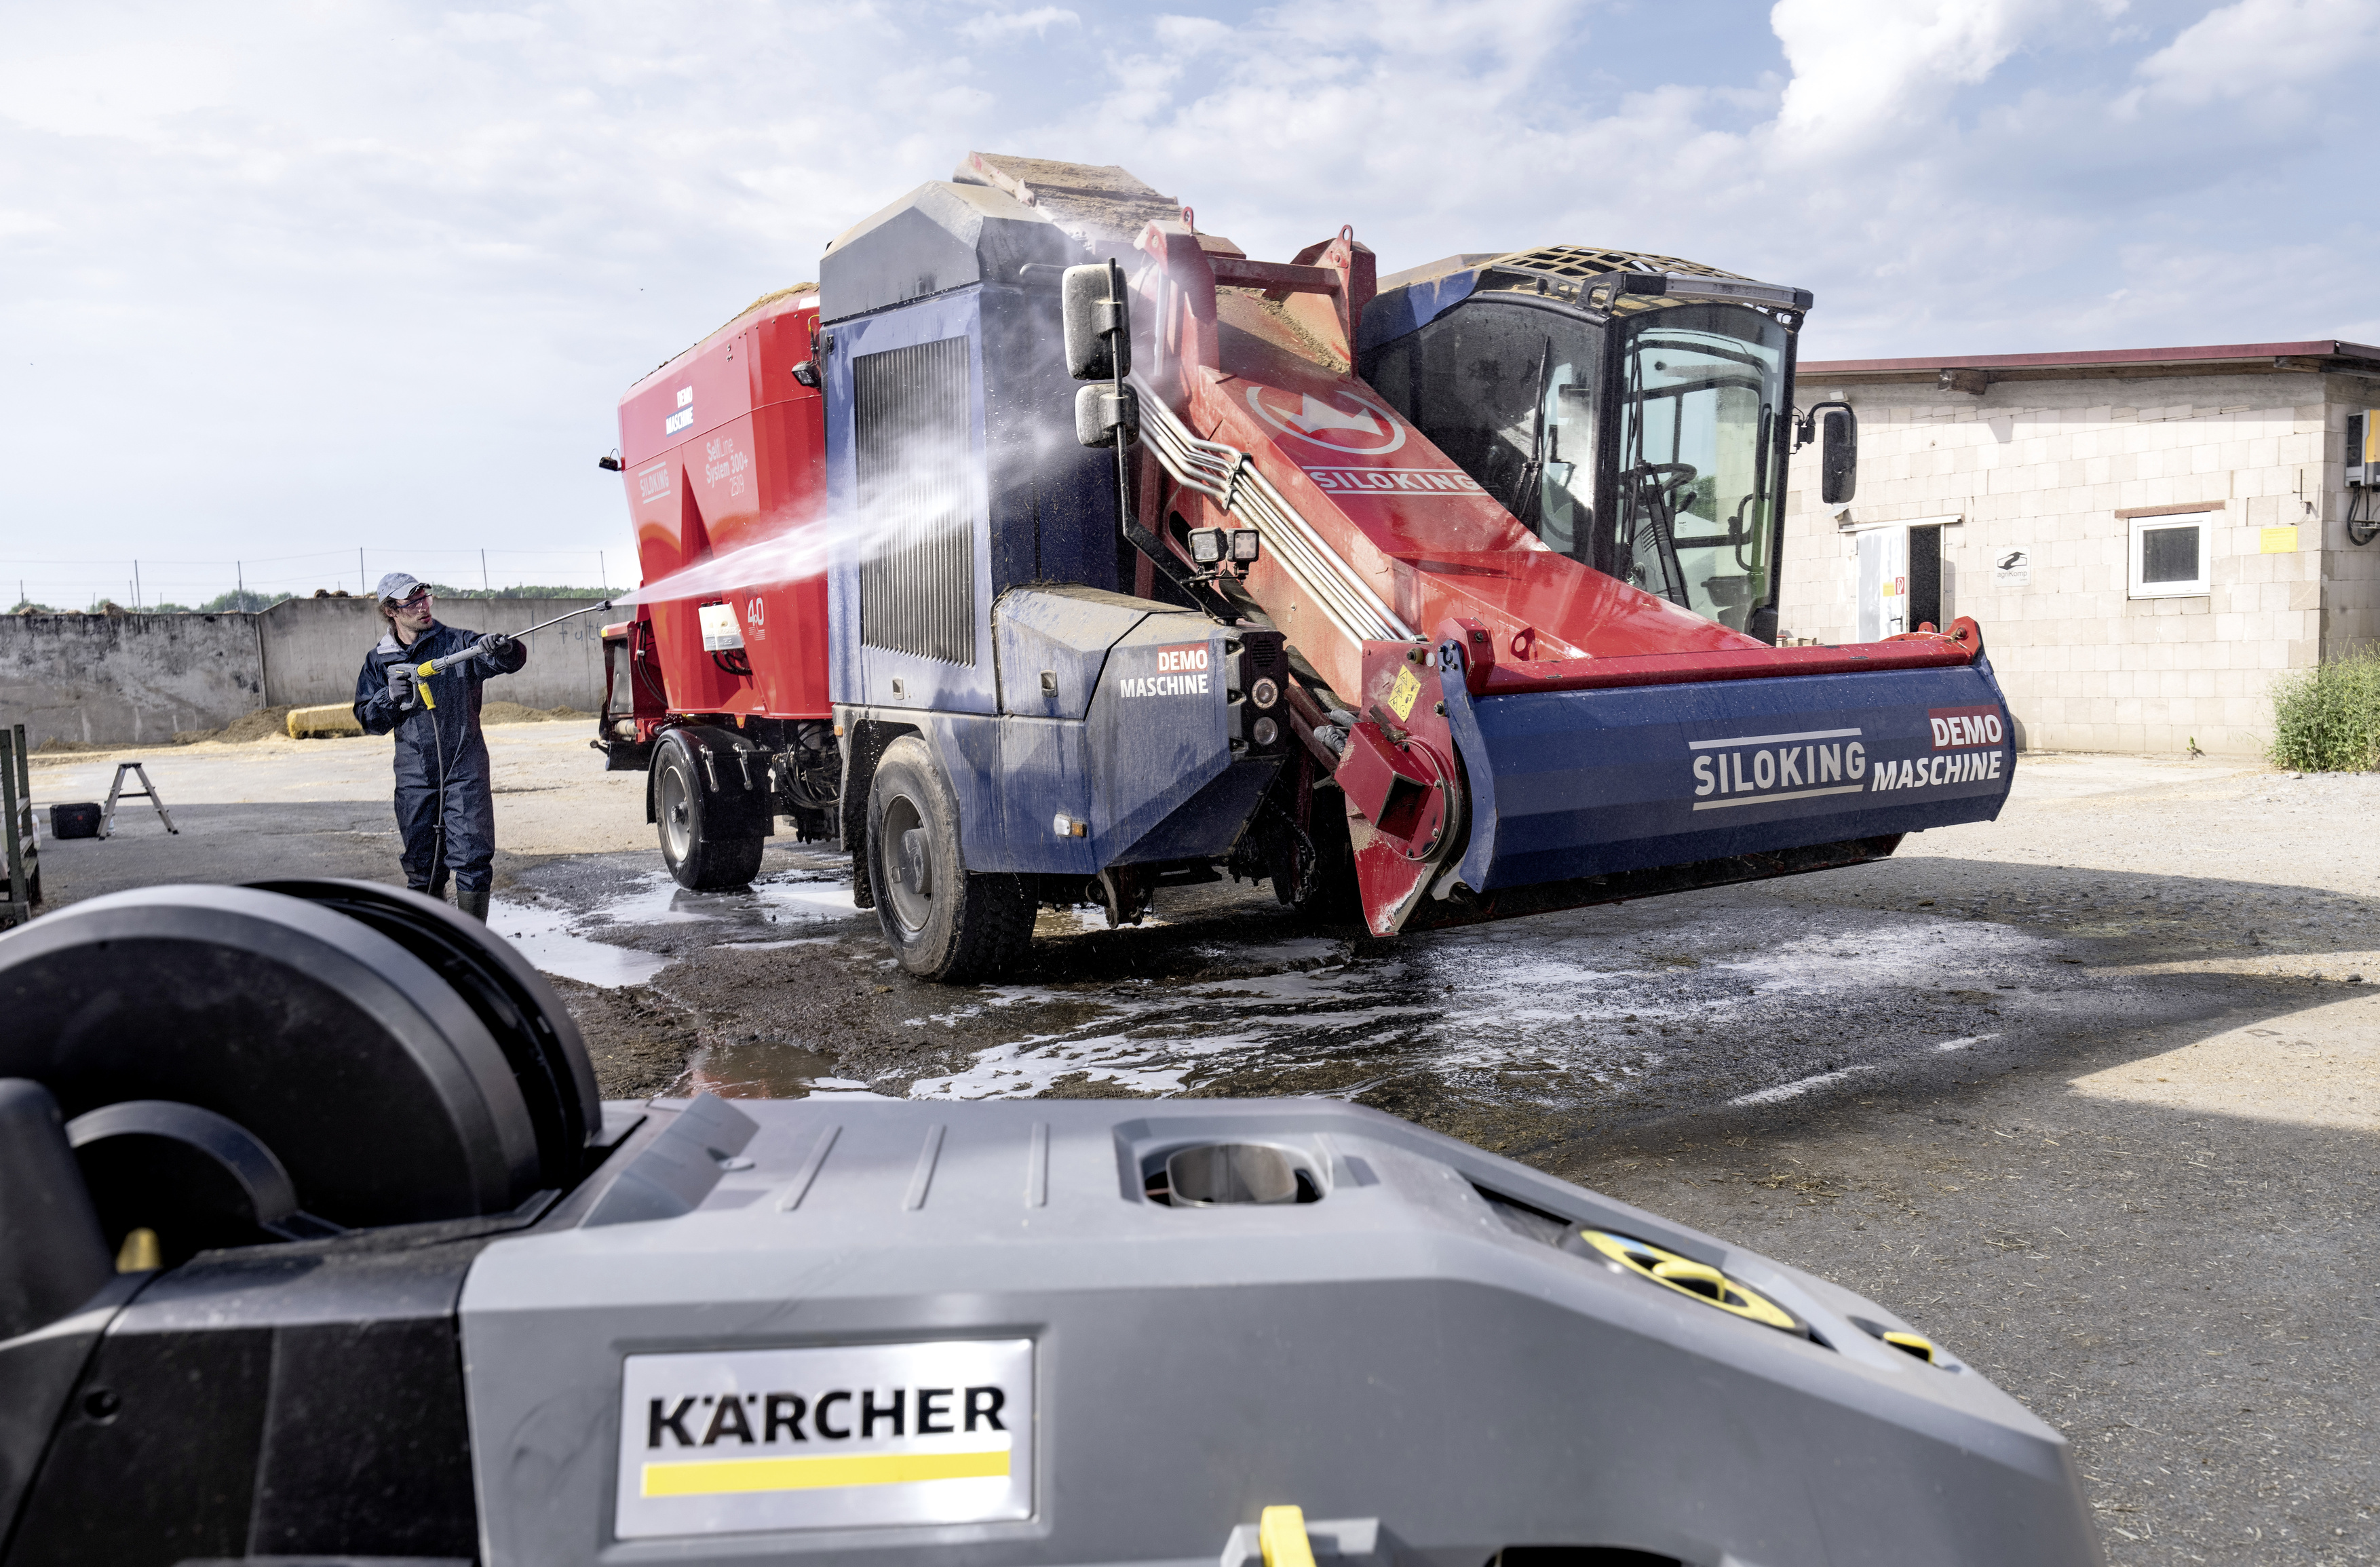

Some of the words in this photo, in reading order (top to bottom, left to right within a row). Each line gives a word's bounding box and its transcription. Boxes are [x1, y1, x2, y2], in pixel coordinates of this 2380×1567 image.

[676, 385, 693, 408] DEMO
[666, 406, 693, 435] MASCHINE
[706, 435, 734, 462] SelfLine
[640, 469, 669, 498] SILOKING
[706, 461, 730, 488] System
[730, 451, 748, 474] 300+
[1309, 471, 1480, 490] SILOKING
[1158, 649, 1208, 672] DEMO
[1120, 674, 1209, 698] MASCHINE
[1930, 714, 2002, 747] DEMO
[1693, 741, 1866, 796] SILOKING
[1871, 750, 2002, 792] MASCHINE
[648, 1385, 1008, 1448] KÄRCHER
